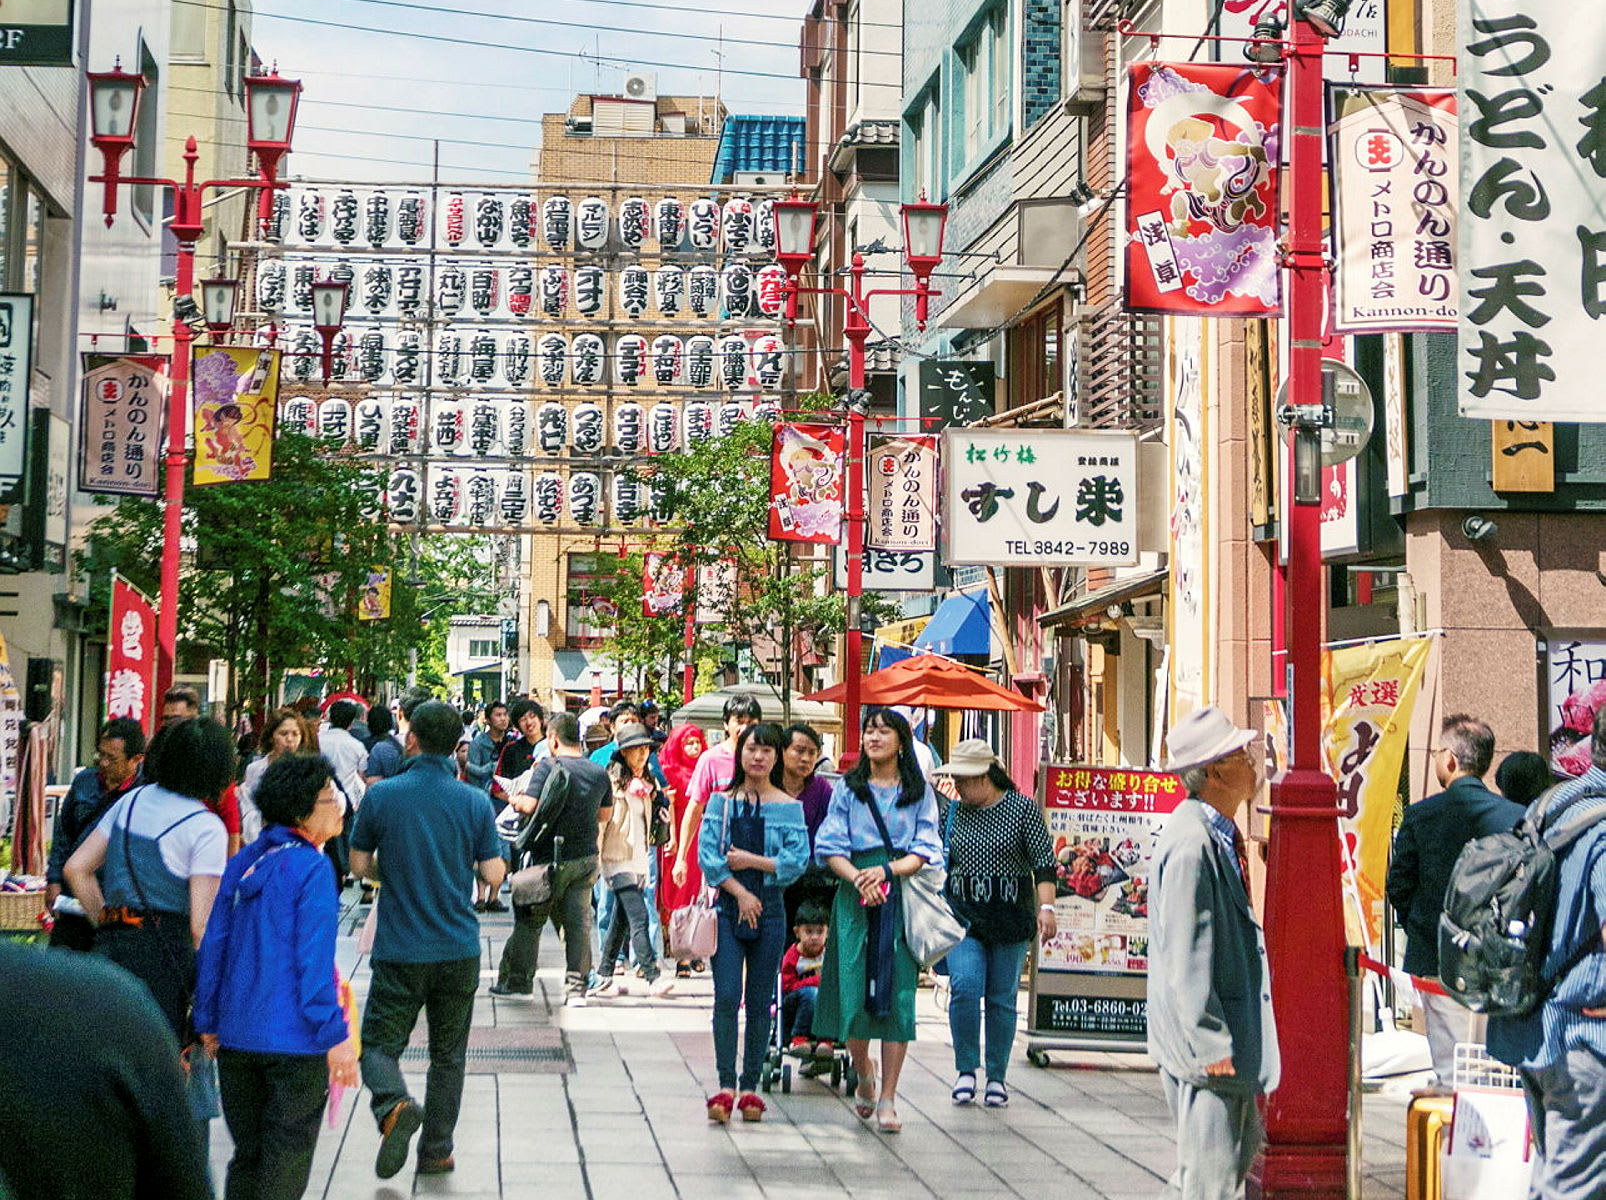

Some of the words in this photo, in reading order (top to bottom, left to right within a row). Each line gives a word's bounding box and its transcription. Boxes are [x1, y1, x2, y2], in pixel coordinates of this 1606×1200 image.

[299, 194, 320, 236] いなは
[509, 199, 531, 244] 魚きち
[691, 202, 715, 246] ひらい
[1410, 120, 1453, 301] かんのん通り
[1141, 220, 1177, 285] 浅草
[1370, 179, 1396, 299] メトロ商店会
[439, 274, 460, 310] 丸仁
[472, 270, 492, 311] 百助
[1352, 305, 1457, 319] Kannon-do
[653, 339, 674, 382] 十和田
[944, 369, 973, 428] もんじ
[124, 373, 149, 480] かんのん通り
[574, 409, 599, 451] つるや
[966, 443, 1037, 465] 松竹梅
[535, 476, 558, 522] 松むら
[881, 481, 894, 536] メトロ商店会
[901, 450, 922, 539] かんのん通り
[1055, 770, 1178, 794] お得な盛り合せ
[1056, 789, 1155, 811] ございます!!
[1052, 997, 1147, 1016] Tel.03-6860-02
